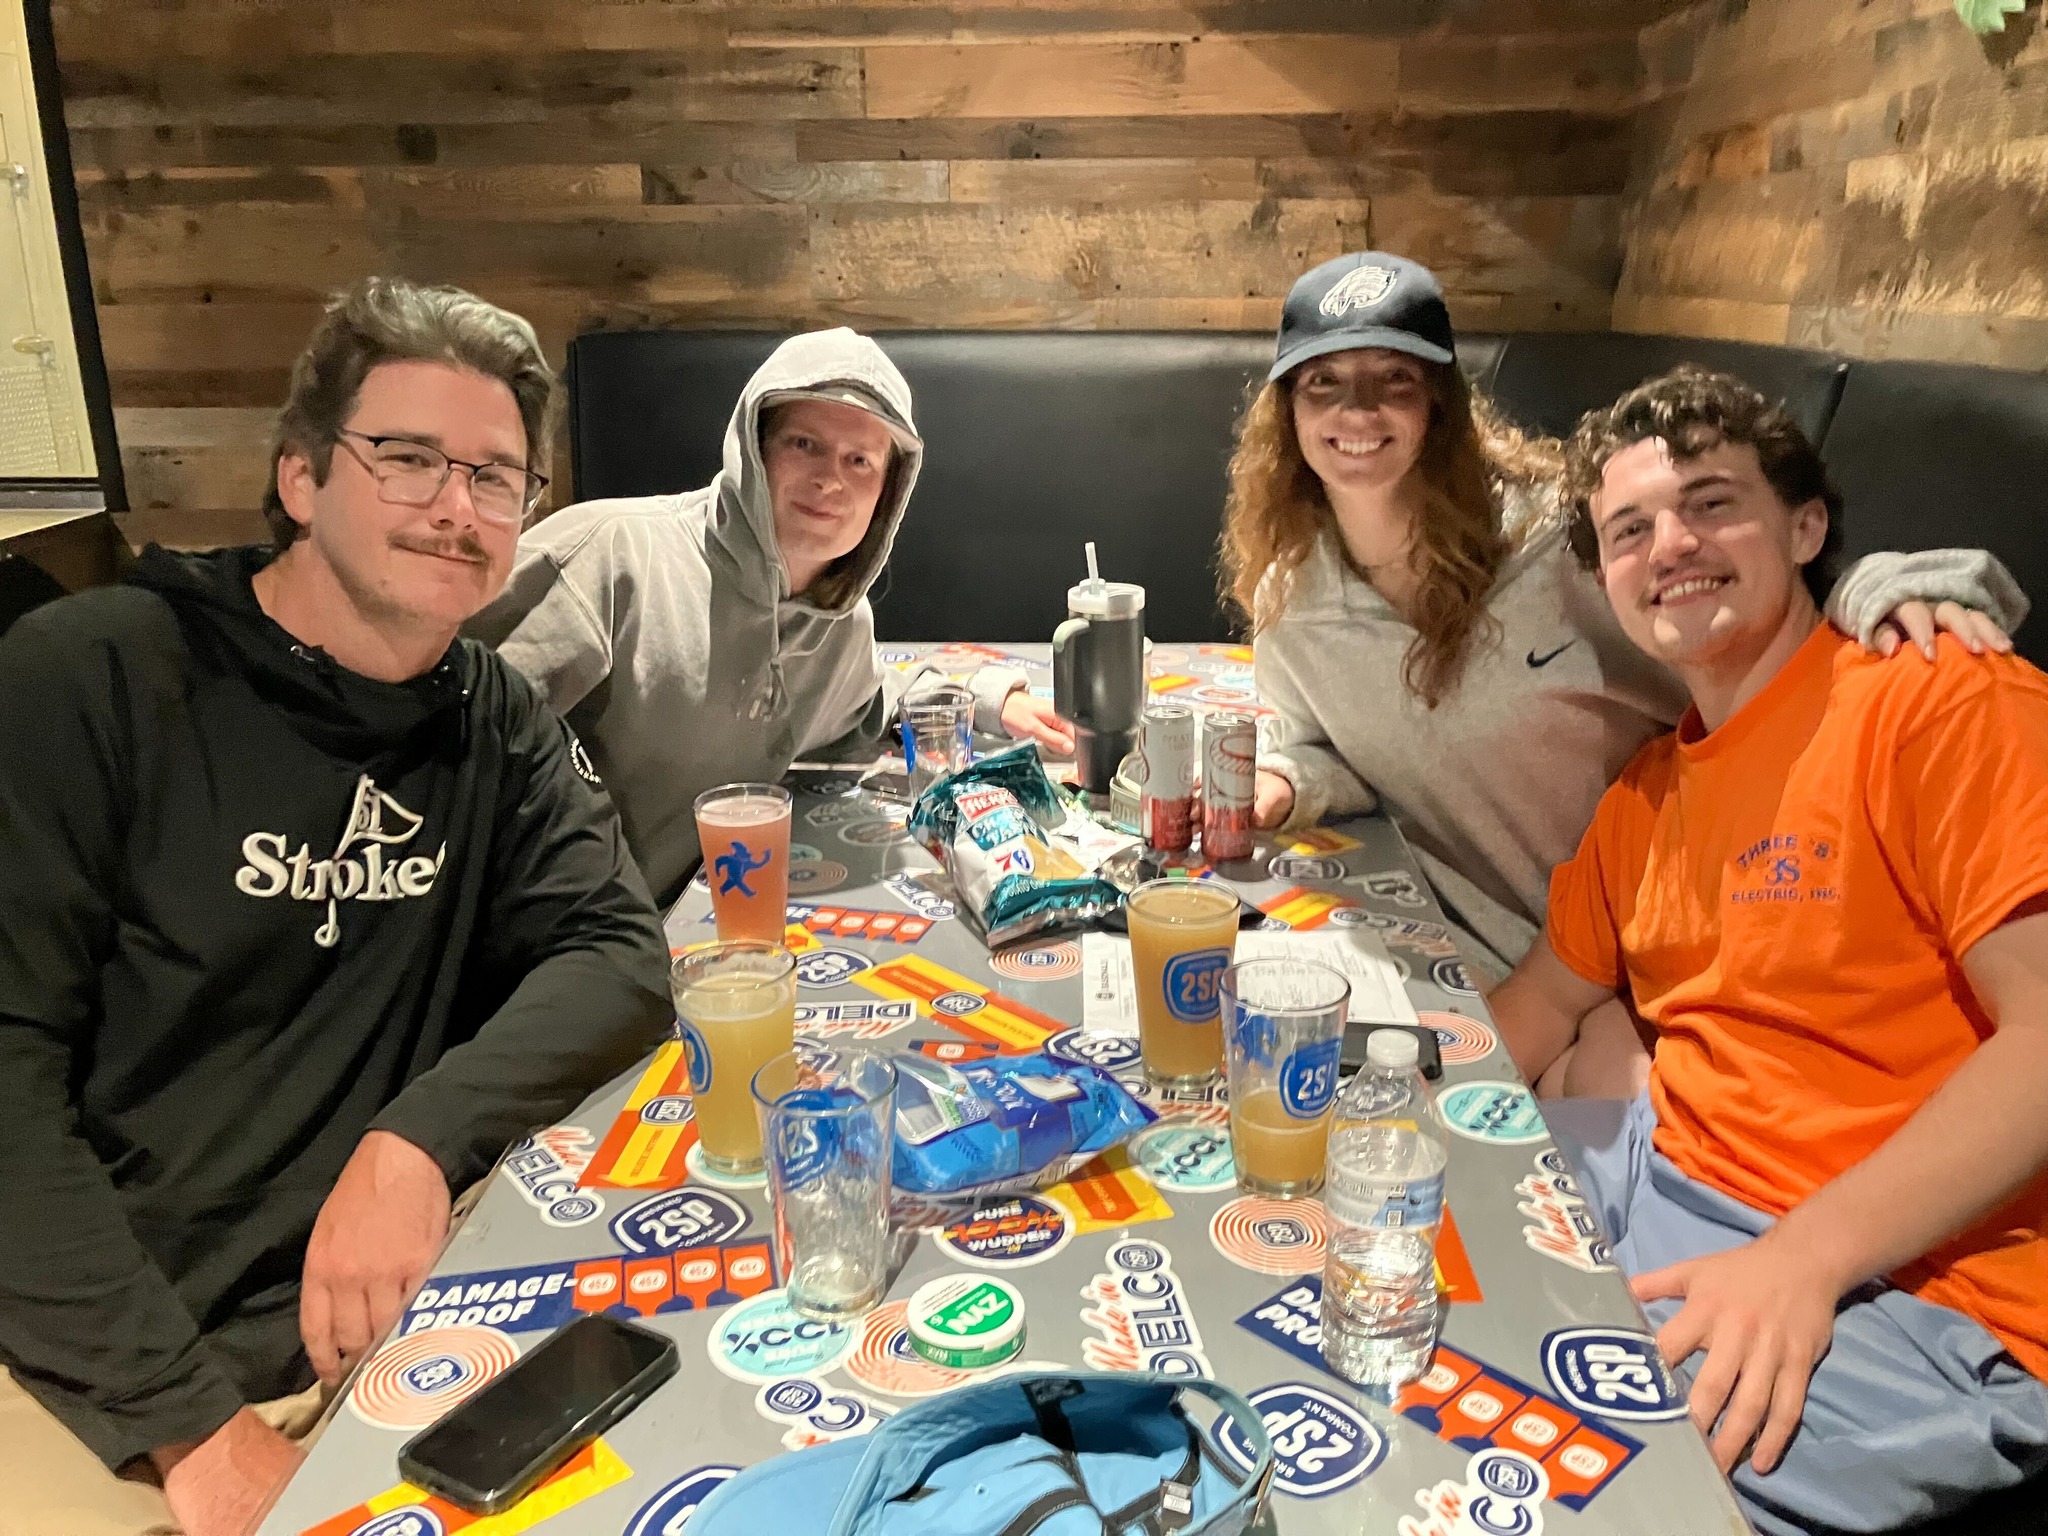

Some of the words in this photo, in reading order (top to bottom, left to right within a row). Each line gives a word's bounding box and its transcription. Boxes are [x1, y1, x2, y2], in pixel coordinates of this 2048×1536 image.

[235, 831, 446, 901] Stroke
[1737, 834, 1798, 868] THREE
[795, 1003, 911, 1021] DELC
[1298, 1063, 1332, 1100] 2S
[786, 1117, 820, 1159] 2S
[505, 1140, 597, 1221] ELCO
[638, 1199, 715, 1248] 2SP
[950, 1207, 1063, 1244] 100%
[972, 1203, 1024, 1222] PURE
[966, 1230, 1051, 1252] WUDDER
[409, 1271, 580, 1312] DAMAGE-
[404, 1298, 536, 1335] PROOF
[945, 1292, 1009, 1334] ZYN
[1254, 1303, 1327, 1351] PRO
[412, 1360, 455, 1390] 2SP
[1583, 1343, 1662, 1404] 2SP
[1301, 1399, 1358, 1440] COMPANY
[1262, 1408, 1354, 1474] 2SP
